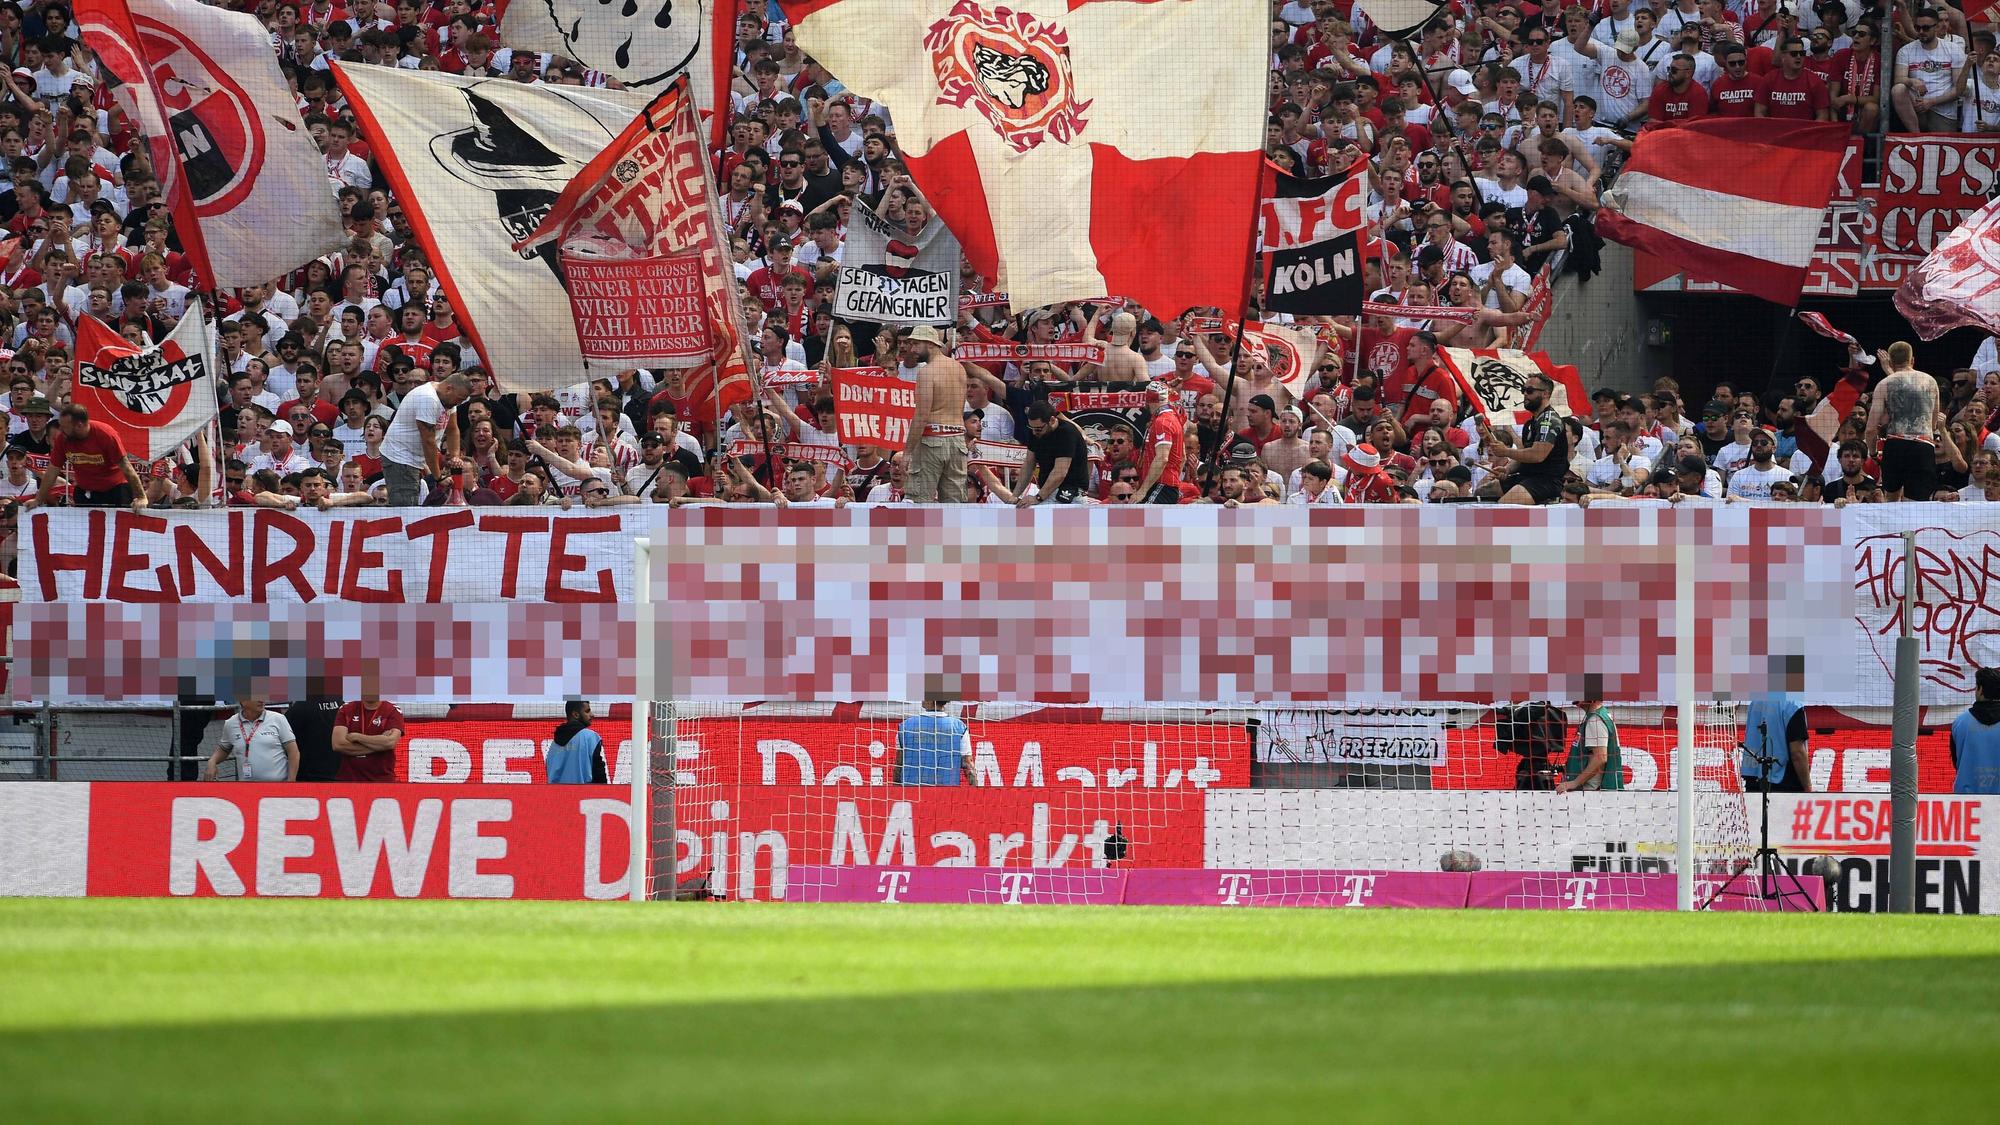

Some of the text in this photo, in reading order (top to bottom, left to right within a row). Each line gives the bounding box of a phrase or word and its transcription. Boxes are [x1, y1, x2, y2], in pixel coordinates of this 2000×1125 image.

[1720, 90, 1753, 100] CHAOTIX
[1771, 91, 1806, 101] CHAOTIX
[1885, 144, 1996, 196] SPS
[1881, 206, 1977, 256] CG
[568, 262, 697, 279] DIE WAHRE GRÖSSE
[842, 269, 876, 286] SEIT
[901, 273, 948, 294] TAGEN
[1273, 248, 1355, 295] KÖLN
[571, 276, 700, 297] EINER KURVE
[575, 296, 701, 316] WIRD AN DER
[847, 290, 948, 318] GEFANGENER
[579, 314, 704, 337] ZAHL IHRER
[584, 334, 706, 352] FEINDE BEMESSEN!
[840, 383, 916, 408] DON'T BEL
[840, 413, 913, 444] THE HY
[31, 509, 622, 603] HENRIETTE
[1338, 737, 1387, 758] FREE
[169, 797, 515, 897] REWE
